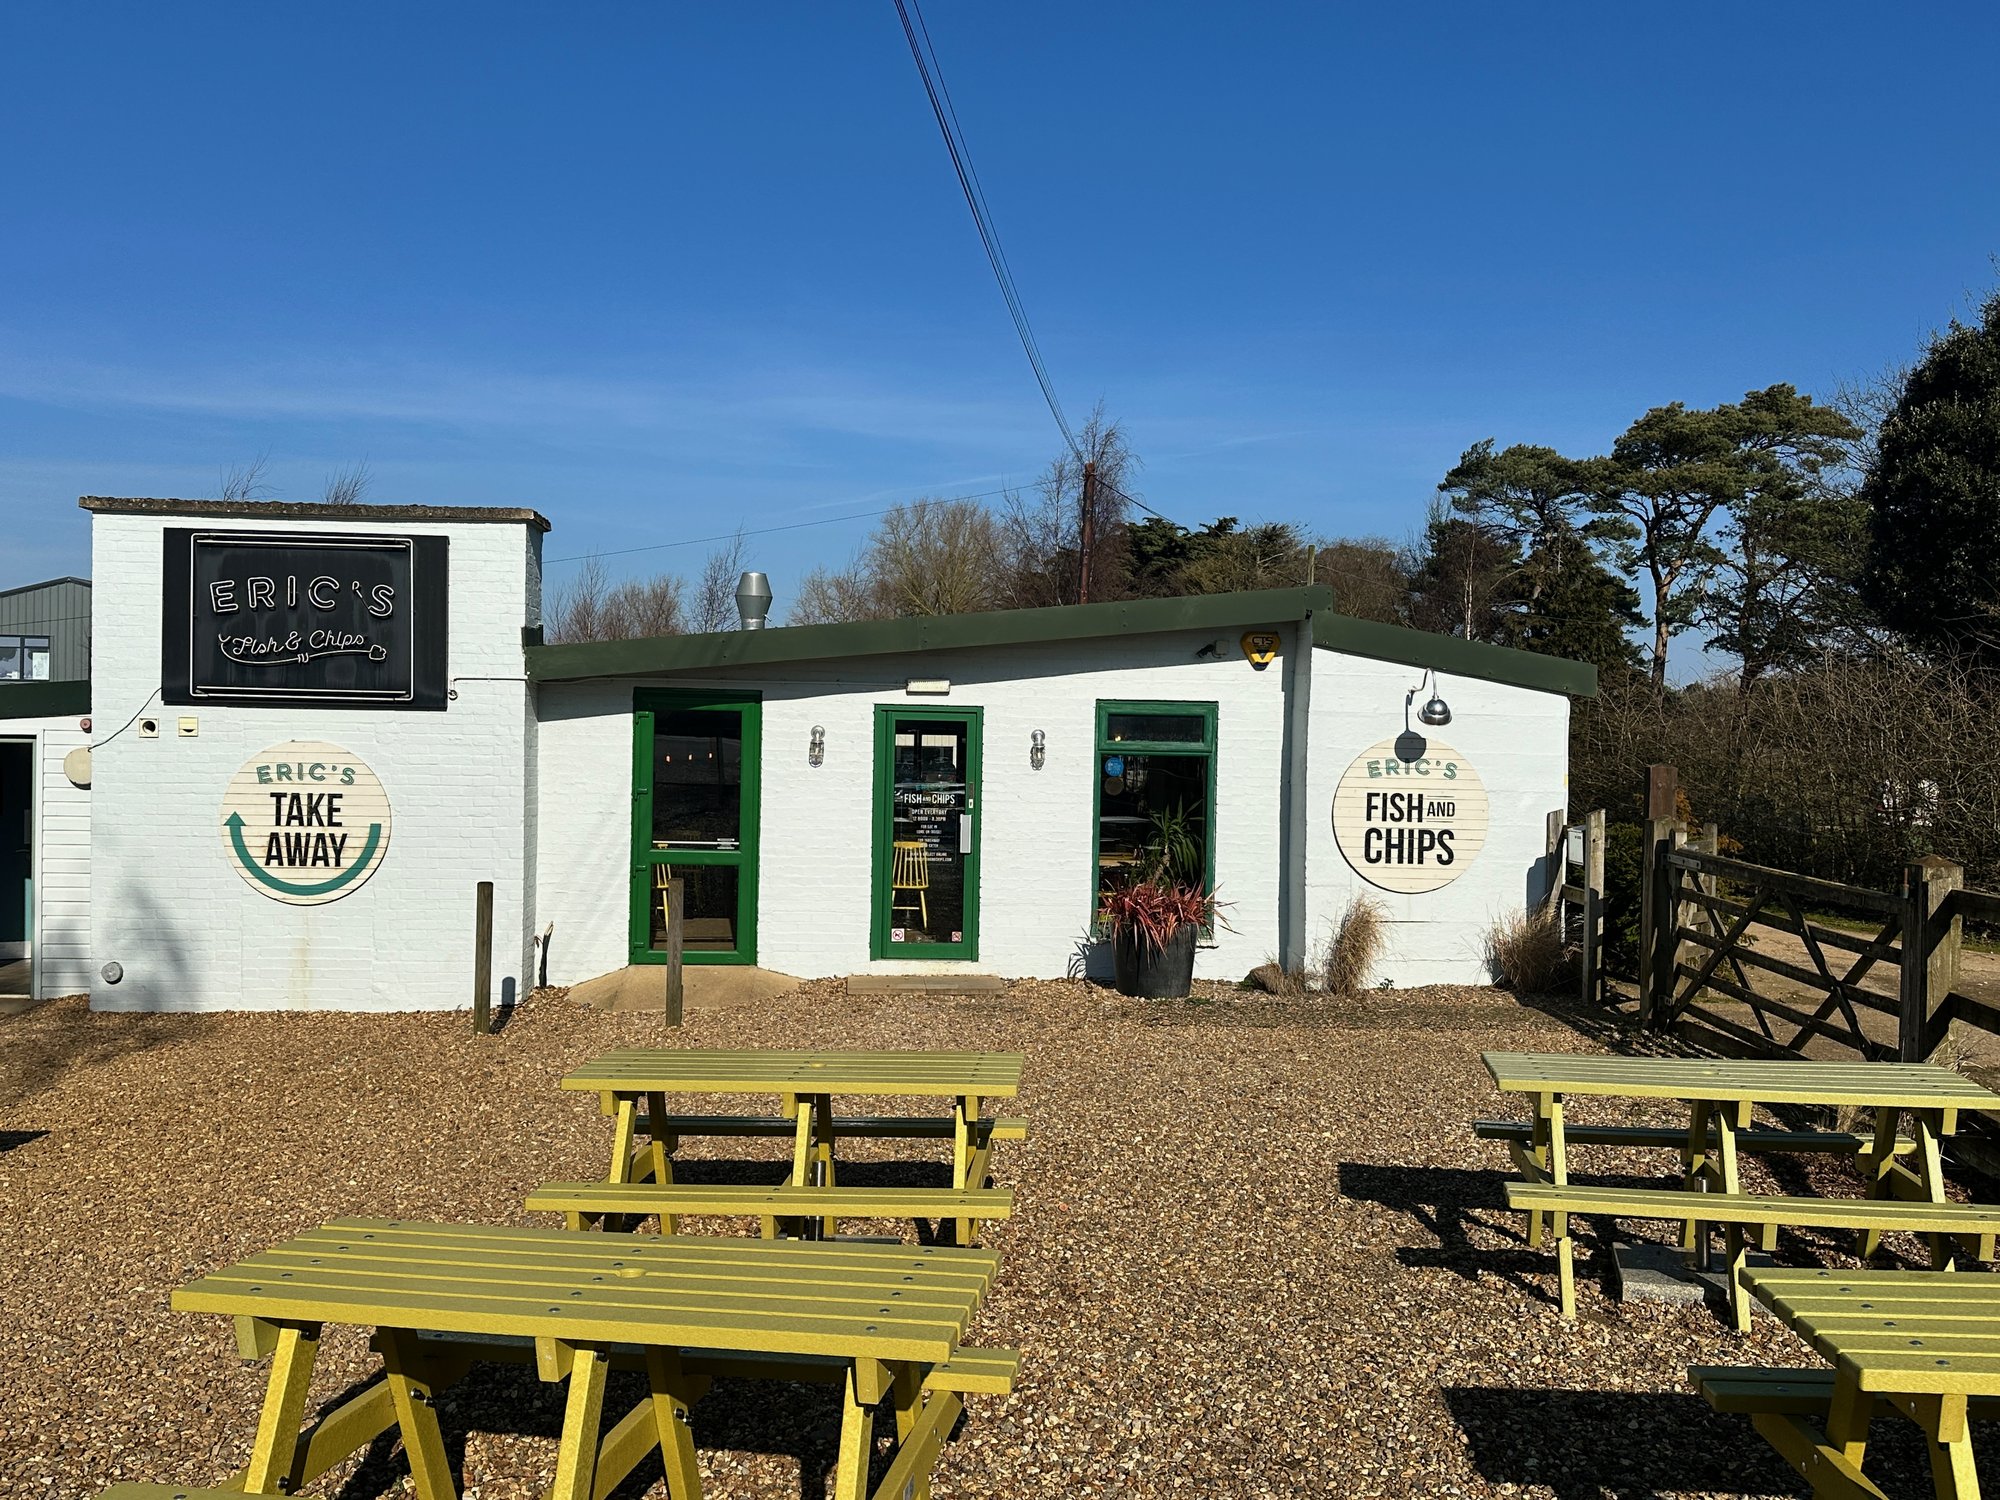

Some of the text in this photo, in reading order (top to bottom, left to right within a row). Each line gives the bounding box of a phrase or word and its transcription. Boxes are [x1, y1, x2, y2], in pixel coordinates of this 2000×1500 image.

[209, 575, 395, 618] ERIC'S
[232, 629, 366, 656] Fish & Chips
[256, 762, 356, 786] ERIC'S
[1366, 758, 1458, 780] ERIC'S
[270, 792, 343, 827] TAKE
[904, 793, 922, 804] FISH
[931, 793, 955, 804] CHIPS
[1366, 792, 1456, 823] FISH AND
[265, 832, 348, 867] AWAY
[1364, 827, 1455, 866] CHIPS
